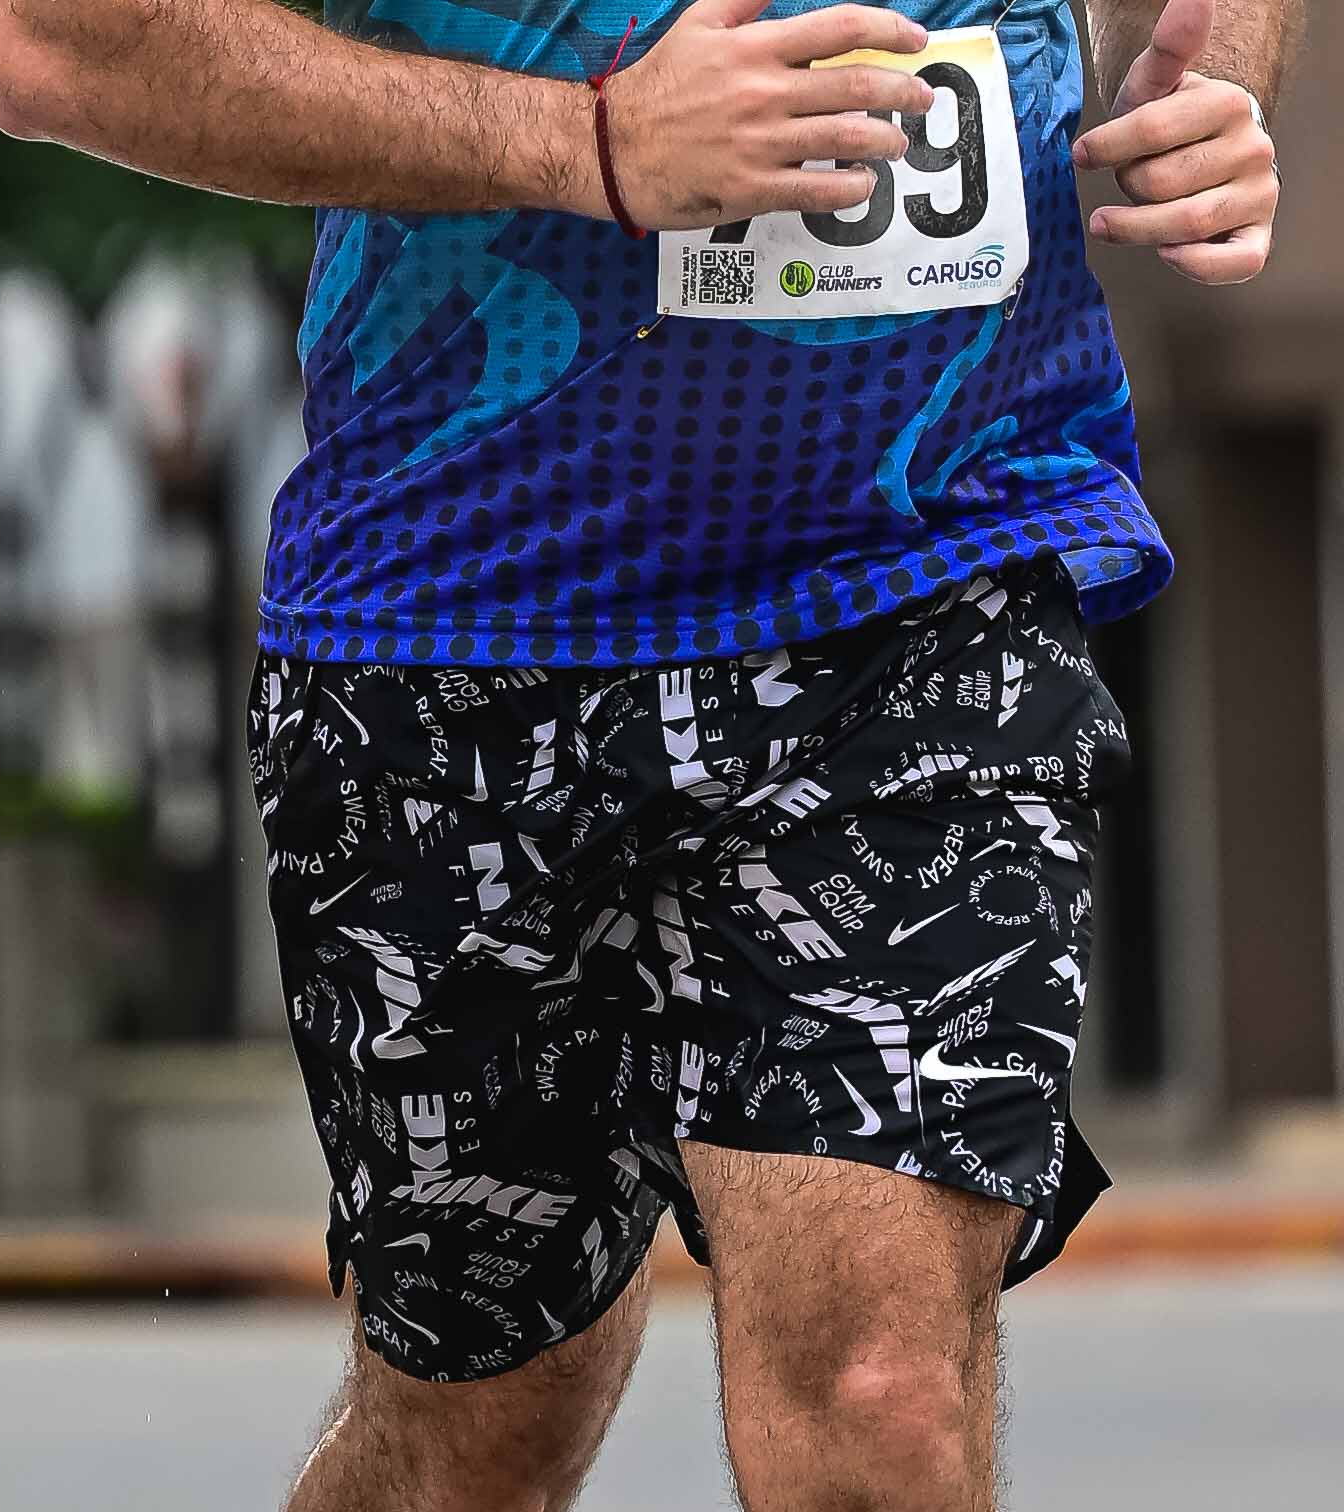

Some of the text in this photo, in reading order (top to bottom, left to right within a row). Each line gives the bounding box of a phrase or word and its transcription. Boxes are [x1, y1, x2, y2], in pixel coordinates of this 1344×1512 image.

[818, 265, 854, 278] CLUB
[907, 260, 1002, 286] CARUSO
[1020, 626, 1093, 677] SWEAT
[432, 671, 468, 712] GYM
[956, 674, 974, 706] GYM
[415, 695, 450, 777] REPEAT
[336, 779, 366, 860] SWEAT
[917, 824, 965, 890] REPEAT
[1005, 865, 1038, 882] PAIN
[808, 880, 865, 935] EQUIP.
[829, 874, 878, 916] GYM
[968, 869, 996, 904] SWEAT
[977, 911, 1032, 926] REPEAT
[336, 926, 429, 1060] NIKE
[535, 1042, 564, 1103] SWEAT
[744, 1065, 824, 1121] SWEAT PAIN
[940, 1128, 1013, 1198] SWEAT
[1006, 1052, 1058, 1100] GAIN
[463, 1265, 515, 1289] GYM
[460, 1290, 523, 1341] REPEAT
